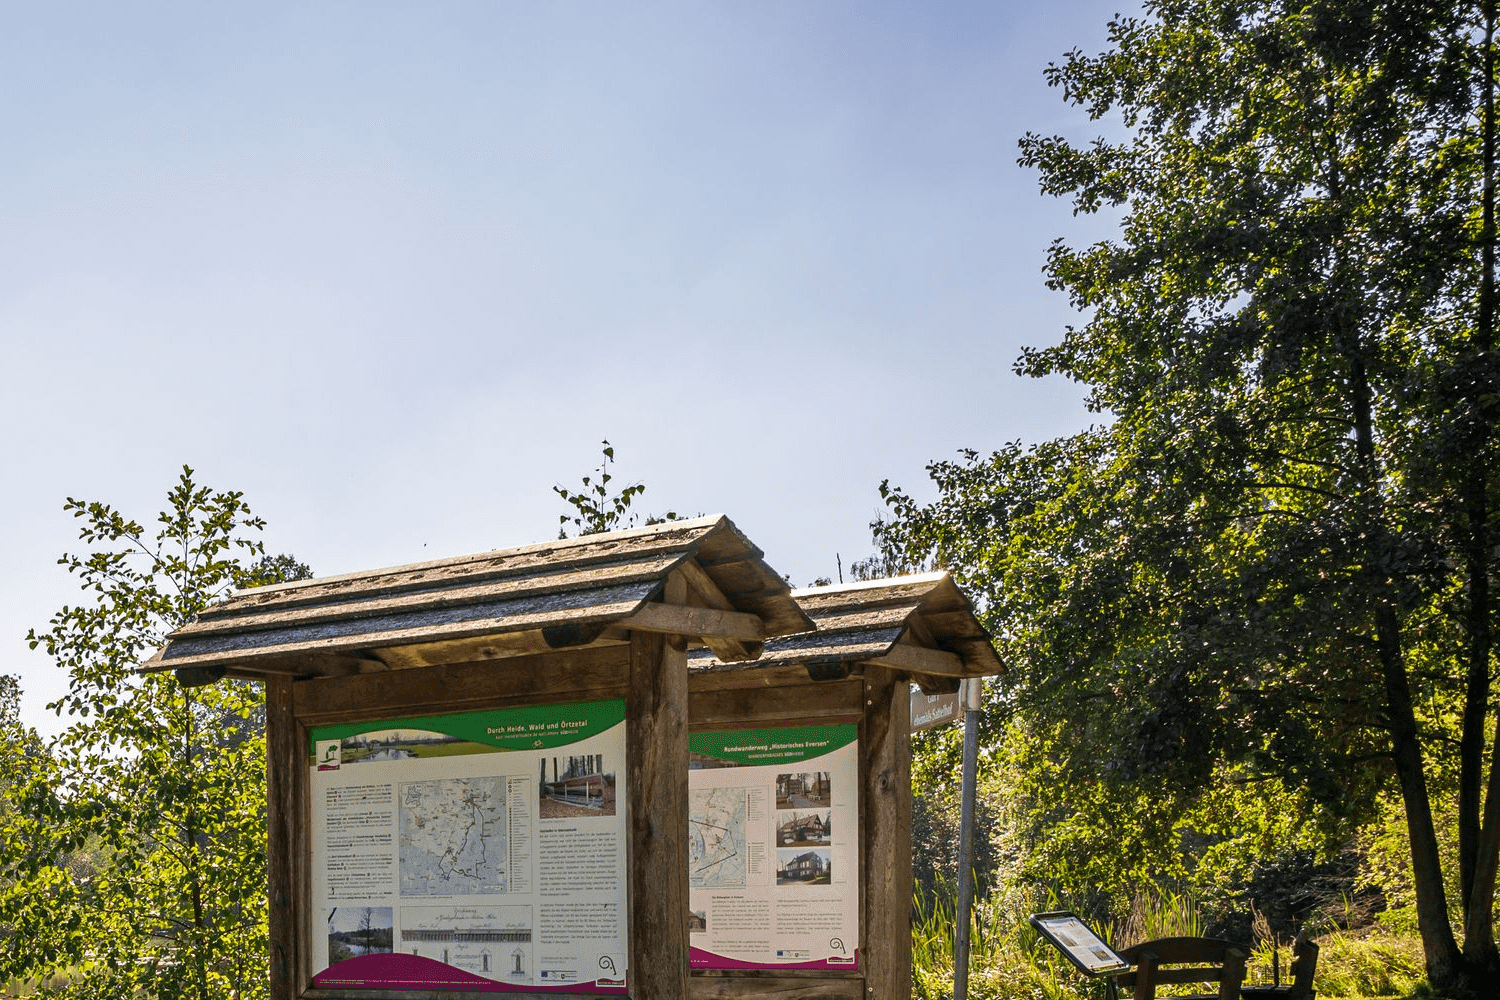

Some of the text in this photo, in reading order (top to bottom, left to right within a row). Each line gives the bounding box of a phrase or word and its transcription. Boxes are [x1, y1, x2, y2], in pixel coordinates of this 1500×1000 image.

[487, 726, 505, 735] Durch
[529, 723, 545, 731] Wald
[546, 721, 559, 729] und
[560, 719, 588, 729] Örtzetal
[724, 744, 768, 753] Rundwanderweg
